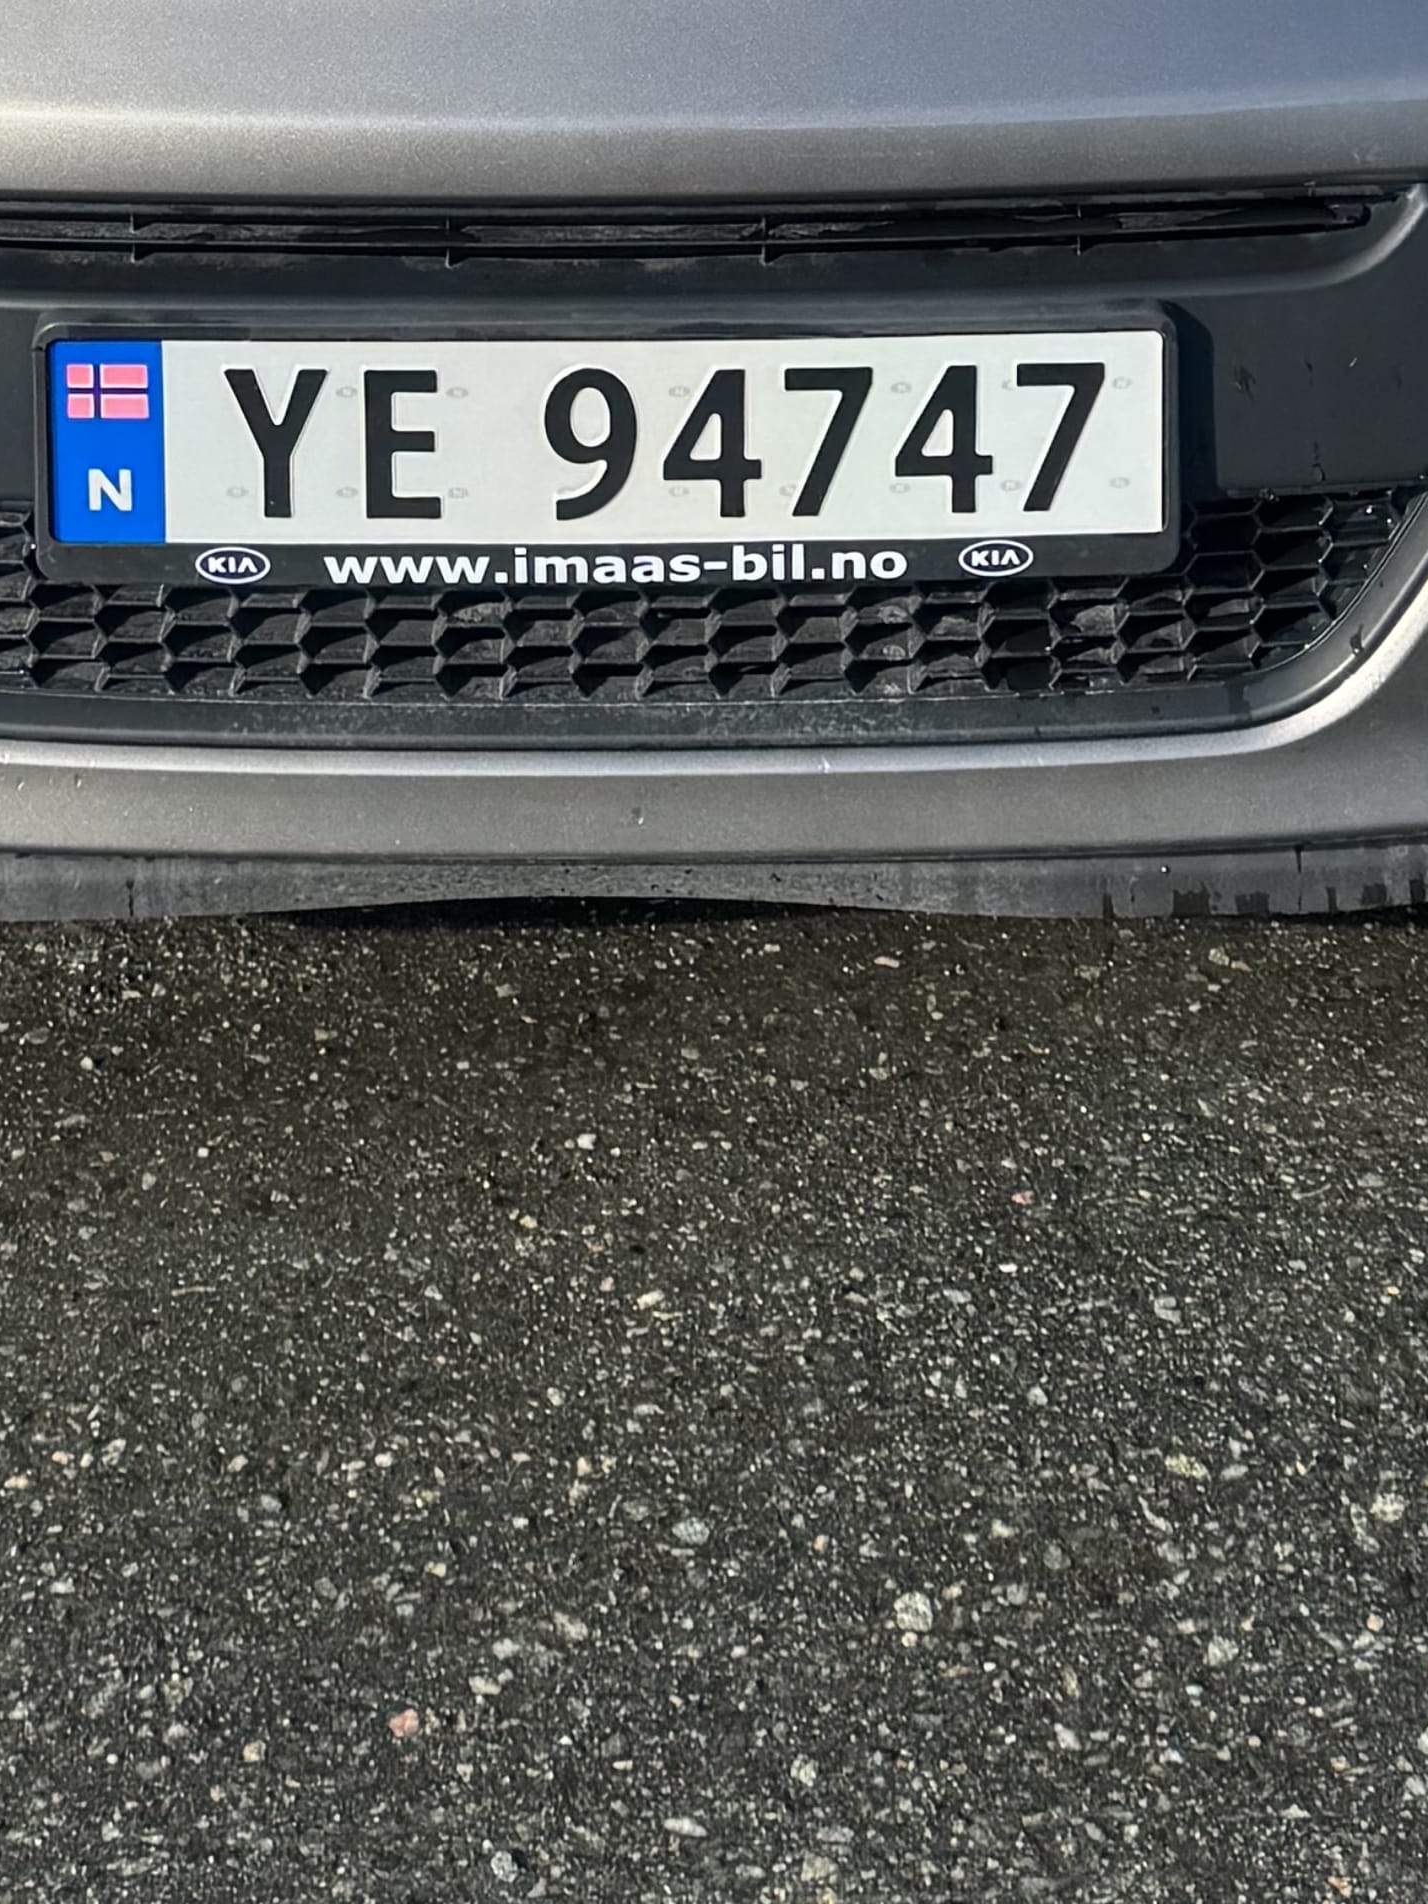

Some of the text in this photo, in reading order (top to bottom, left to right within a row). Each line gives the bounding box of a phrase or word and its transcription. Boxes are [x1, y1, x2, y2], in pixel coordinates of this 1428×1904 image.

[223, 362, 1106, 521] YE 94747
[87, 468, 133, 512] N
[323, 543, 909, 584] www.imaas-bil.no
